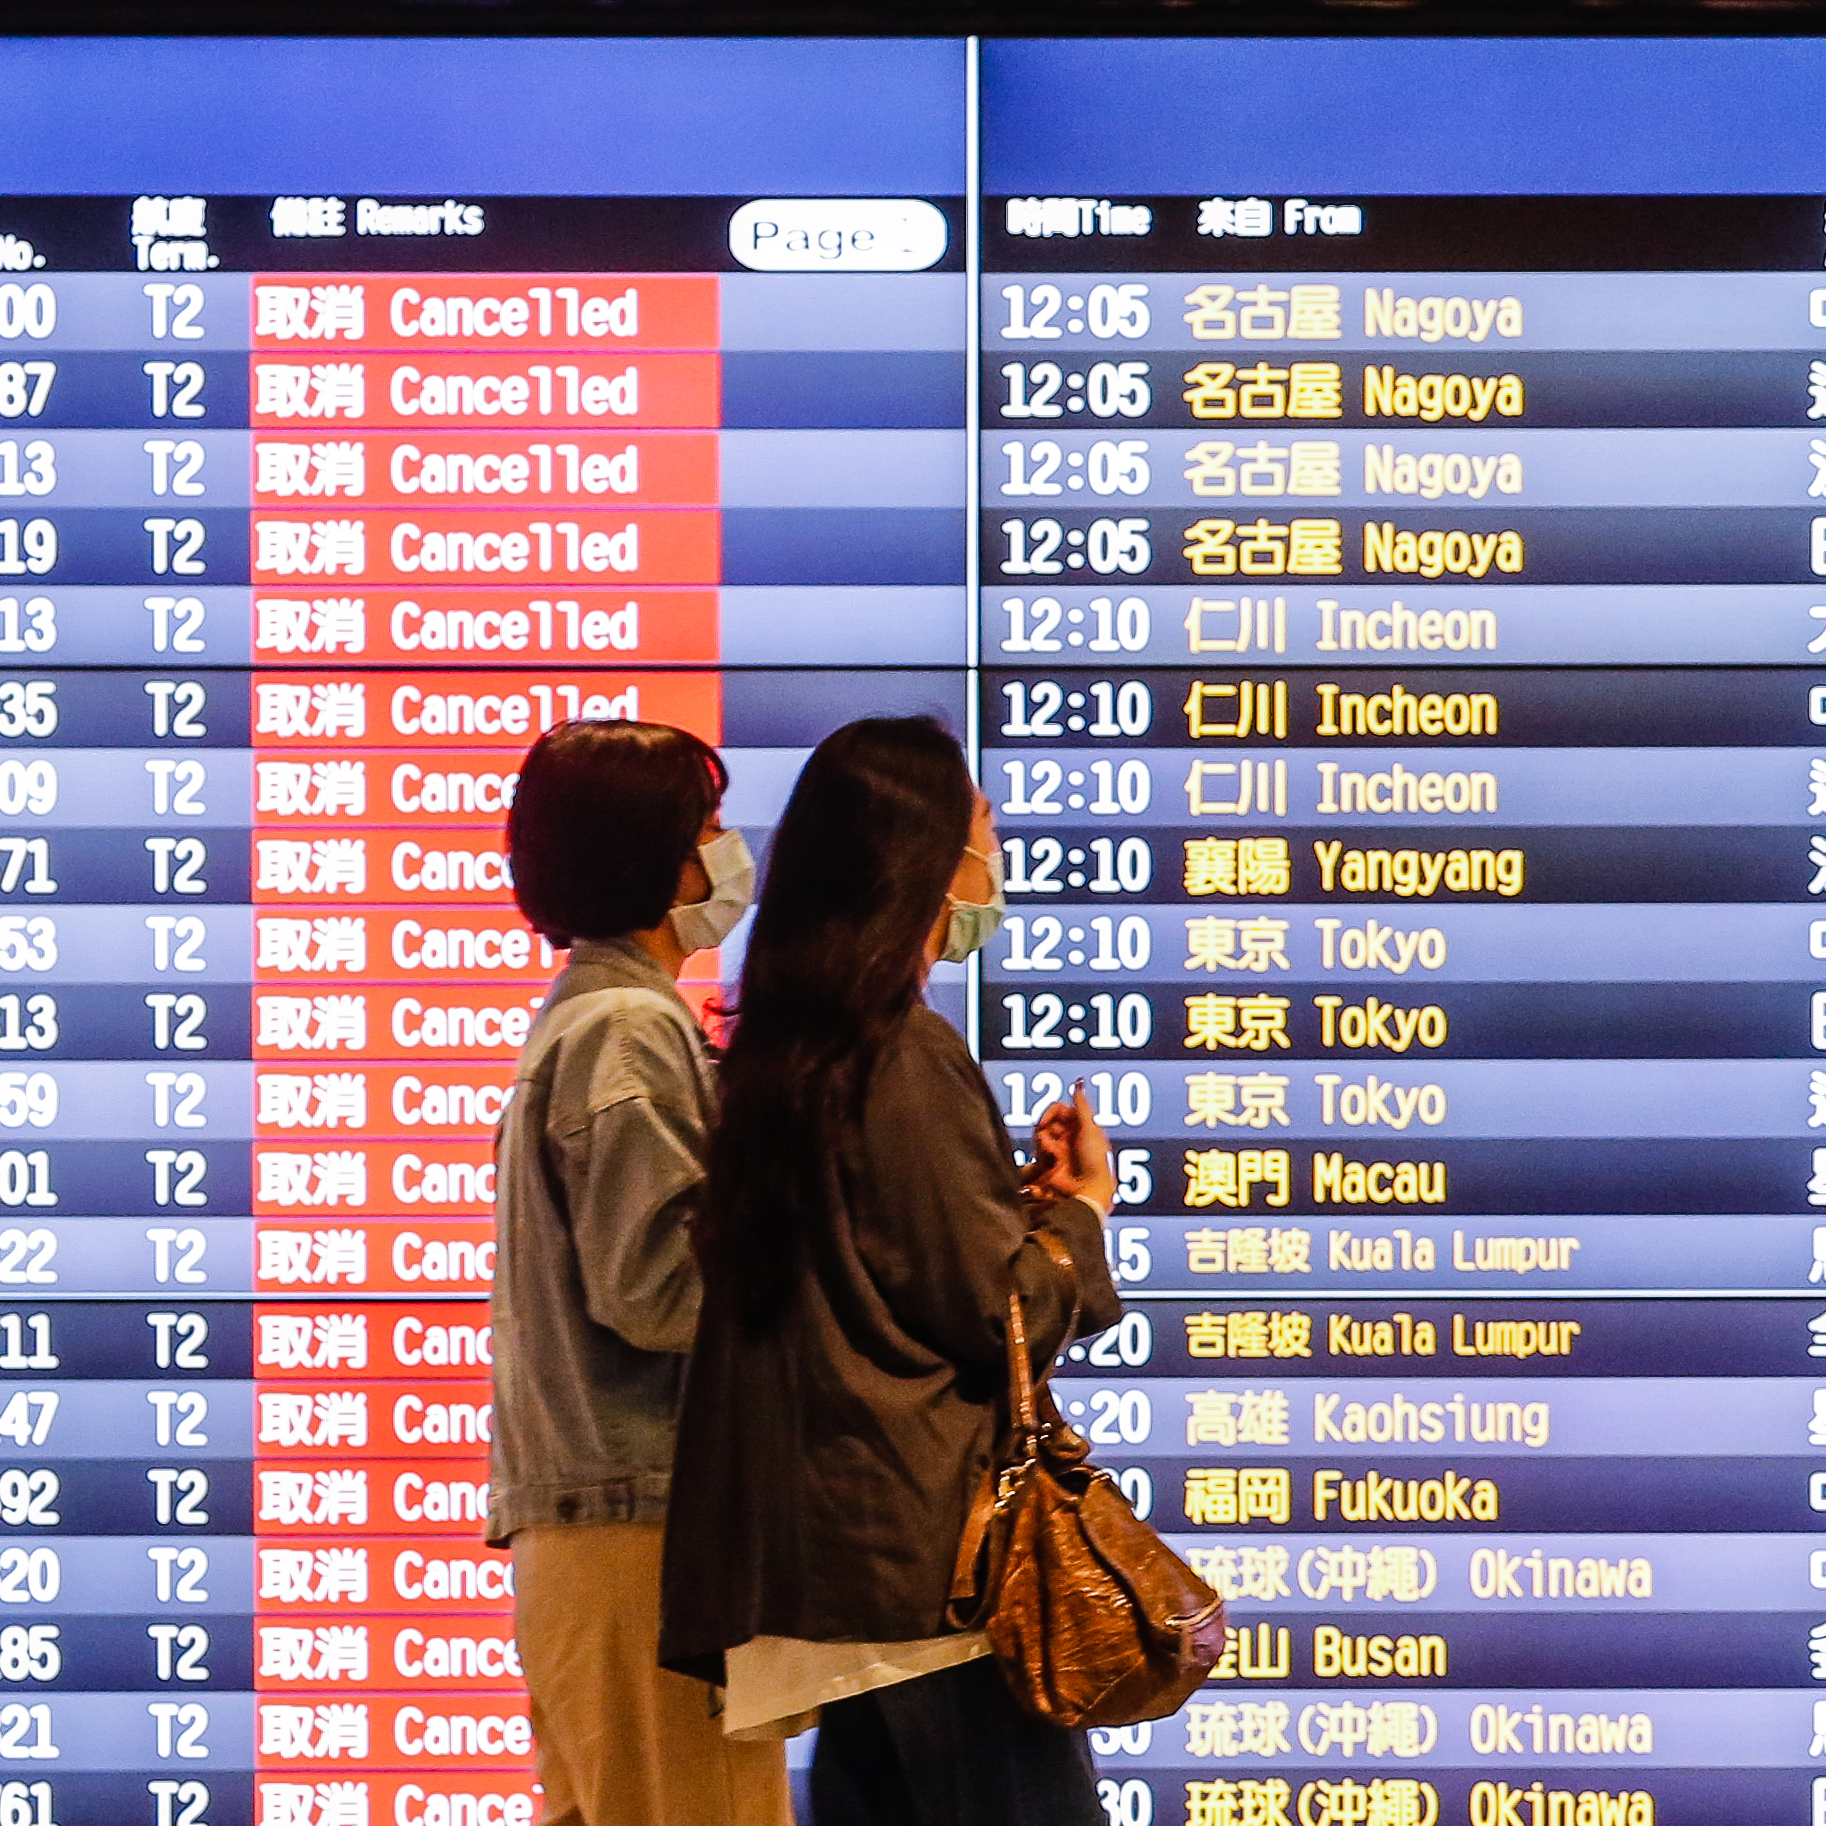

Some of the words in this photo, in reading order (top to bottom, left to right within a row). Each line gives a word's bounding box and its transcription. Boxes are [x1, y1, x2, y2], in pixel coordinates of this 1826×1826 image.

[356, 198, 483, 236] Remarks
[753, 221, 876, 260] Page
[1198, 197, 1271, 237] 來自
[1284, 198, 1361, 236] From
[132, 236, 218, 271] Term.
[143, 361, 204, 417] T2
[254, 363, 365, 419] 取消
[390, 365, 638, 416] Cancelled
[1001, 362, 1150, 417] 12:05
[1181, 360, 1344, 419] 名古屋
[1363, 364, 1524, 423] Nagoya
[143, 518, 205, 574] T2
[255, 519, 365, 576] 取消
[390, 522, 639, 573] Cancelled
[1002, 681, 1150, 736] 12:10
[1182, 679, 1288, 740] 仁川
[1315, 683, 1498, 737] Incheon
[145, 837, 205, 893] T2
[255, 838, 366, 894] 取消
[1003, 837, 1151, 892] 12:10
[1182, 835, 1292, 897] 襄陽
[1312, 839, 1525, 898] Yangyang
[145, 993, 206, 1049] T2
[256, 994, 366, 1051] 取消
[1002, 993, 1150, 1048] 12:10
[1183, 991, 1292, 1052] 東京
[1312, 995, 1448, 1053] Tokyo
[145, 1150, 206, 1205] T2
[256, 1150, 367, 1207] 取消
[1183, 1310, 1313, 1359] 吉隆坡
[1328, 1312, 1437, 1357] Kuala
[1452, 1313, 1582, 1360] Lumpur
[147, 1469, 207, 1524] T2
[258, 1469, 368, 1525] 取消
[1183, 1467, 1291, 1526] 福岡
[1312, 1469, 1499, 1522] Fukuoka
[147, 1625, 208, 1680] T2
[259, 1625, 369, 1681] 取消
